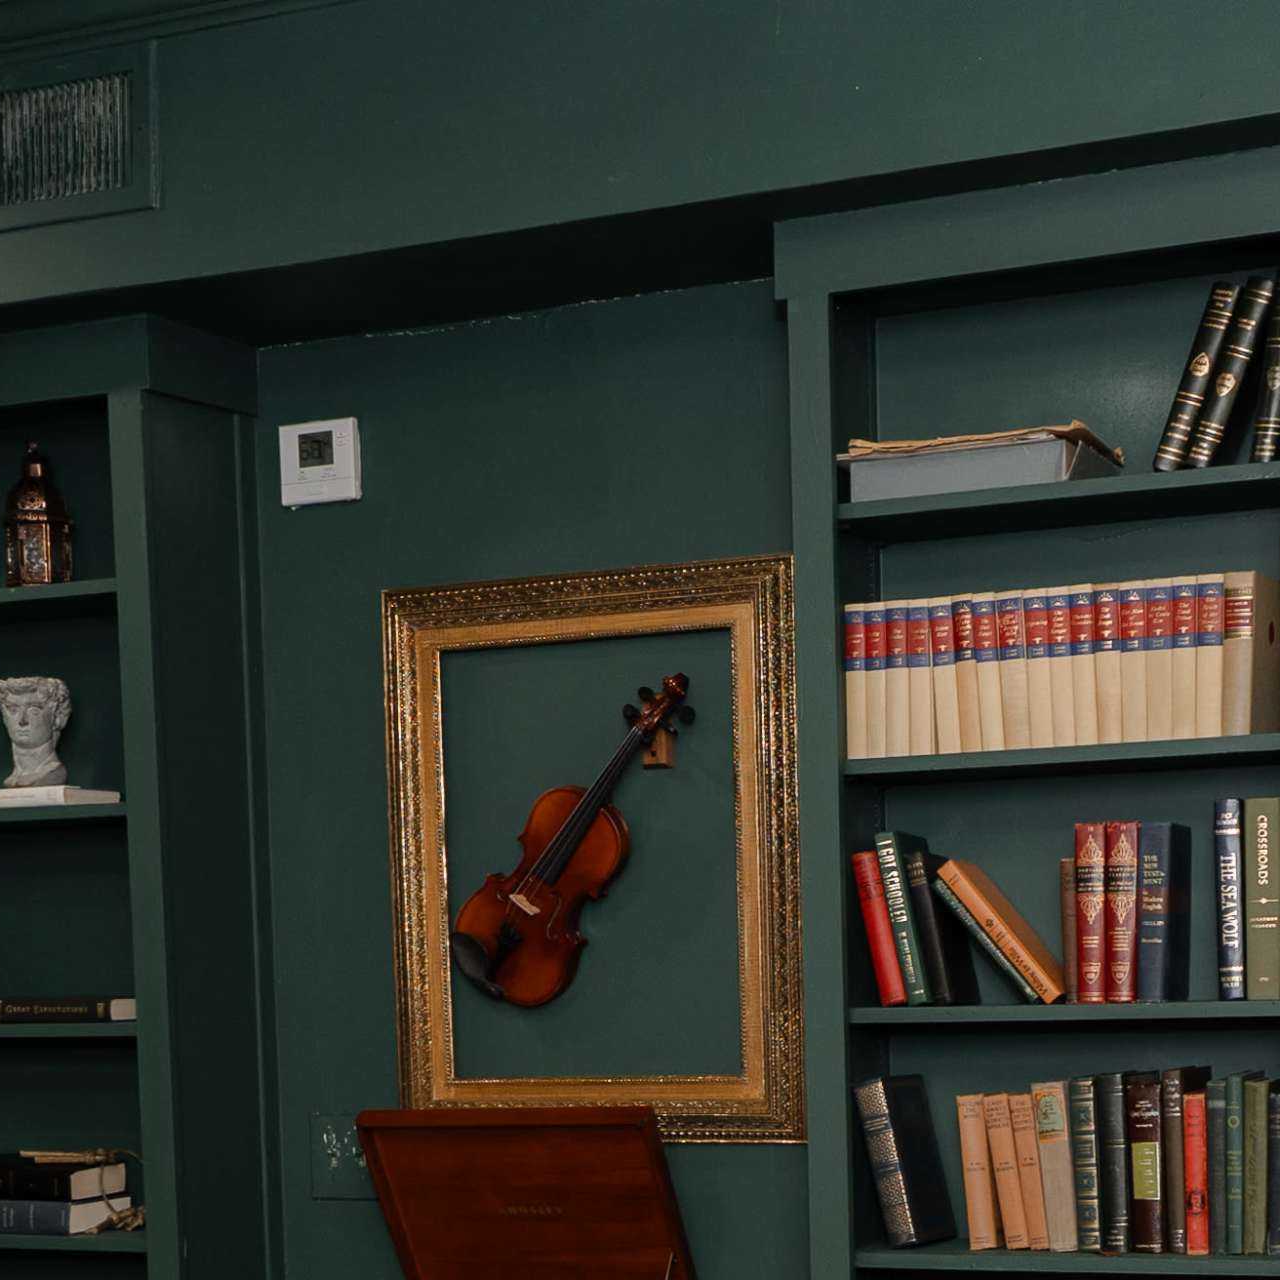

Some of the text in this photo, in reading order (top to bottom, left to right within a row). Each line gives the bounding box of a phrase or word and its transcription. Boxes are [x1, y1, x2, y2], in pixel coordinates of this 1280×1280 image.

[877, 847, 907, 923] GOT SCHOOLED
[1256, 815, 1267, 884] CROSSROADS
[1219, 853, 1238, 948] THE SEA WOLF
